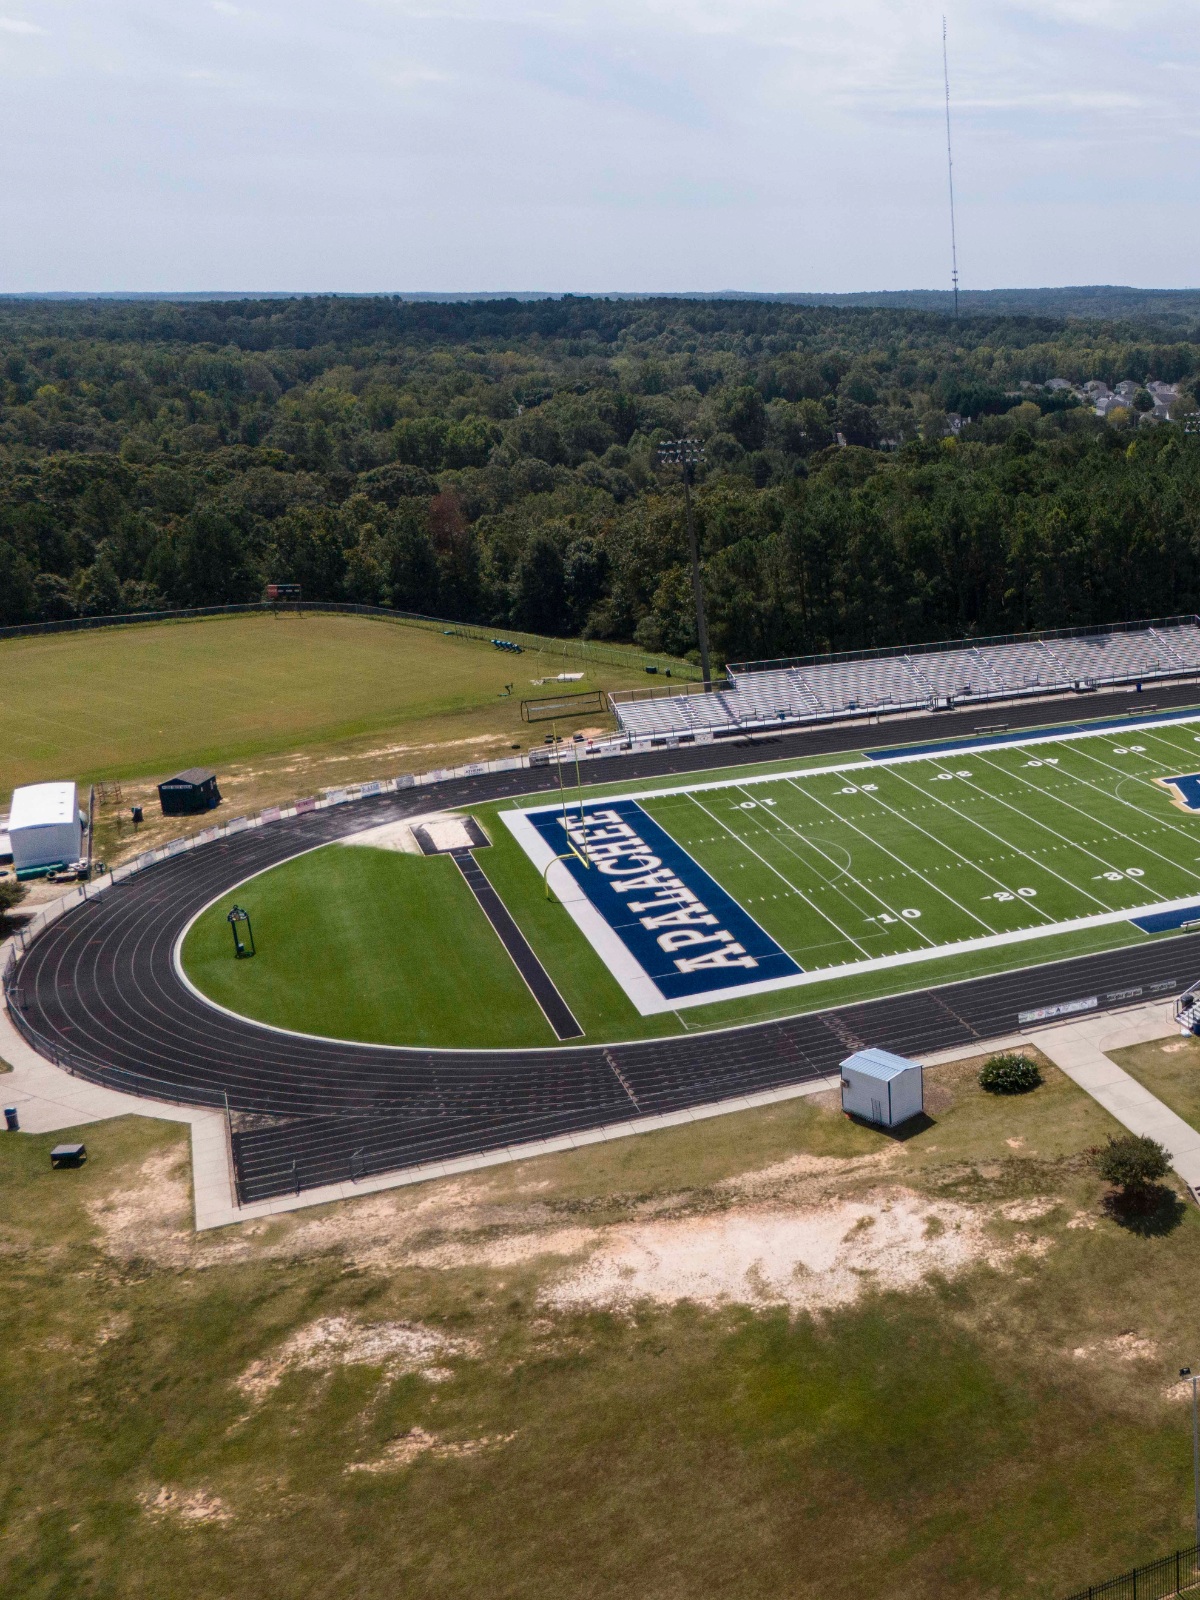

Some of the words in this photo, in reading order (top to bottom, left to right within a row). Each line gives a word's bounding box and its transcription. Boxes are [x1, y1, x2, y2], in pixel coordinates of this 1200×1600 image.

[1112, 745, 1146, 755] 50
[1027, 757, 1059, 767] 40
[937, 770, 973, 780] 30
[842, 783, 879, 794] 20
[739, 798, 777, 809] 10
[1103, 867, 1145, 881] 30
[556, 809, 759, 974] APALACHEE
[993, 887, 1037, 902] 20
[877, 908, 921, 923] 10
